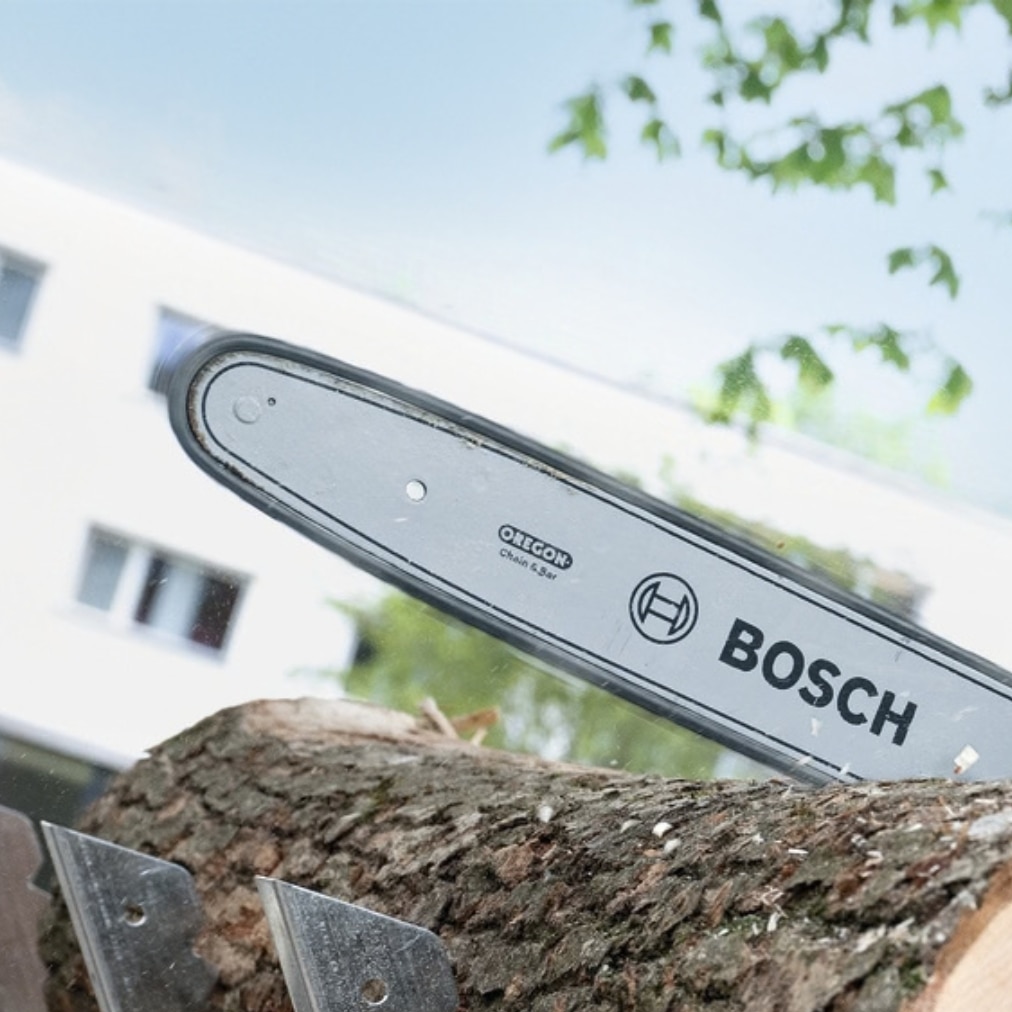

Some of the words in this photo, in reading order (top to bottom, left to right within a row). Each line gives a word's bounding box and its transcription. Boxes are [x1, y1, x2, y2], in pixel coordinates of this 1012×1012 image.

[499, 526, 569, 568] OREGON
[500, 548, 528, 568] Chain
[538, 566, 557, 580] Bar
[718, 617, 918, 746] BOSCH
